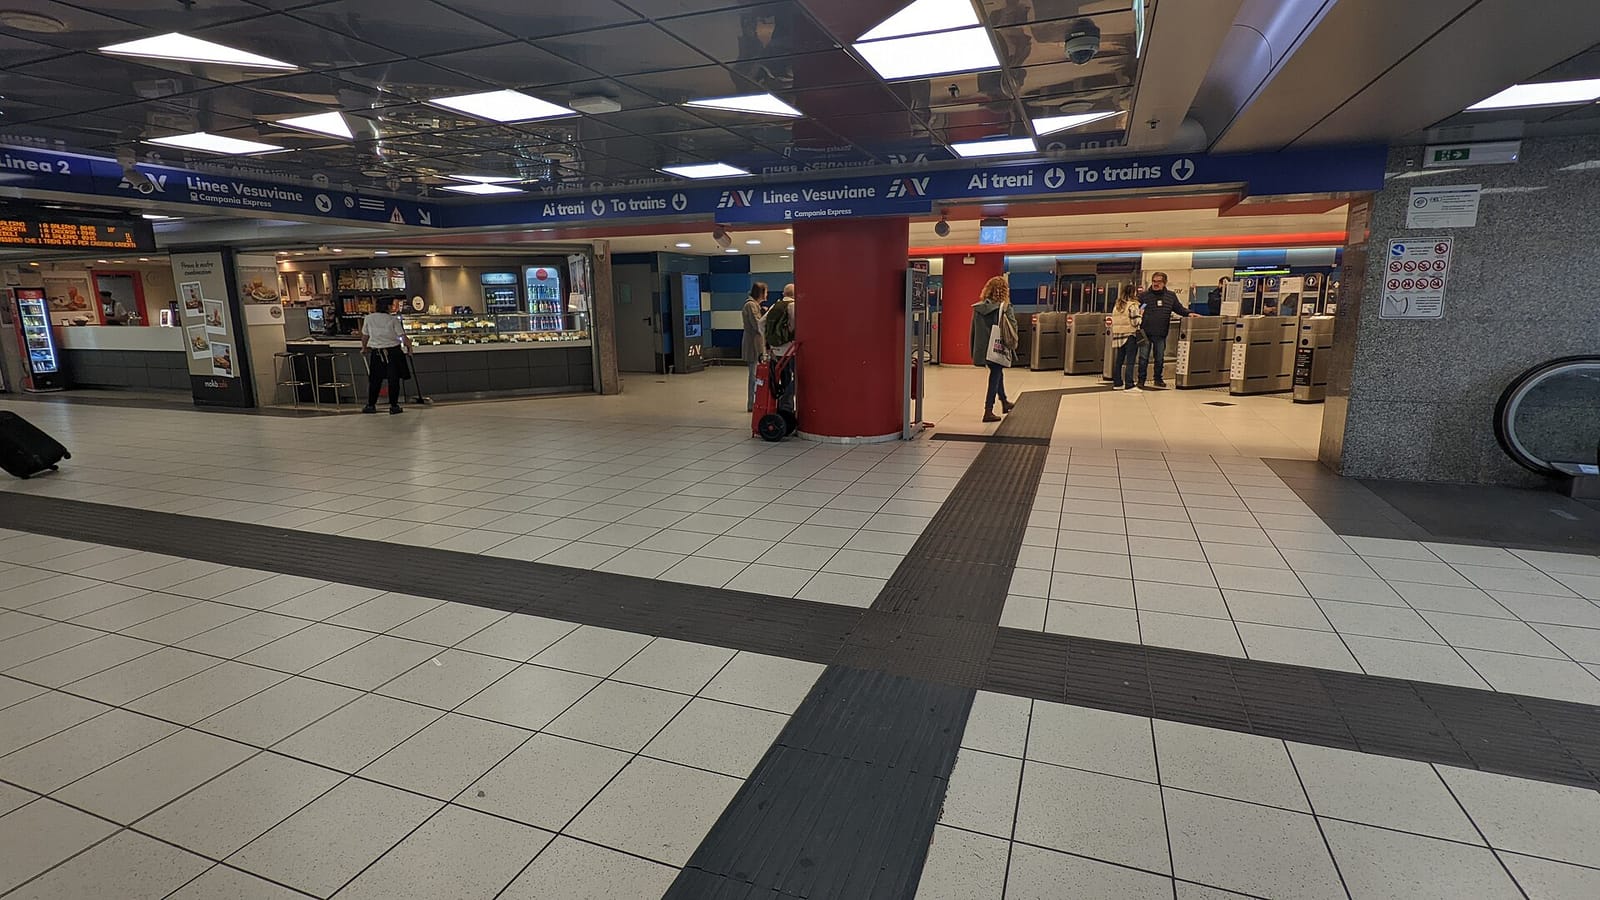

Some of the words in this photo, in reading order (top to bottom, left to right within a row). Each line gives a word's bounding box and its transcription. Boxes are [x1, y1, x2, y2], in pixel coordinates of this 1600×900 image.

[57, 160, 71, 175] 2
[1074, 166, 1098, 183] To
[1103, 162, 1162, 181] trains
[967, 173, 988, 190] Ai
[991, 169, 1034, 188] treni
[187, 176, 229, 194] Linee
[231, 182, 303, 203] Vesuviane
[763, 189, 798, 204] Linee
[802, 185, 876, 202] Vesuviane
[199, 193, 241, 205] Campania
[242, 197, 272, 208] Express
[542, 202, 556, 217] Ai
[557, 201, 585, 215] treni
[611, 199, 626, 213] To
[629, 196, 667, 210] trains
[794, 209, 827, 218] Campania
[827, 208, 852, 217] Express
